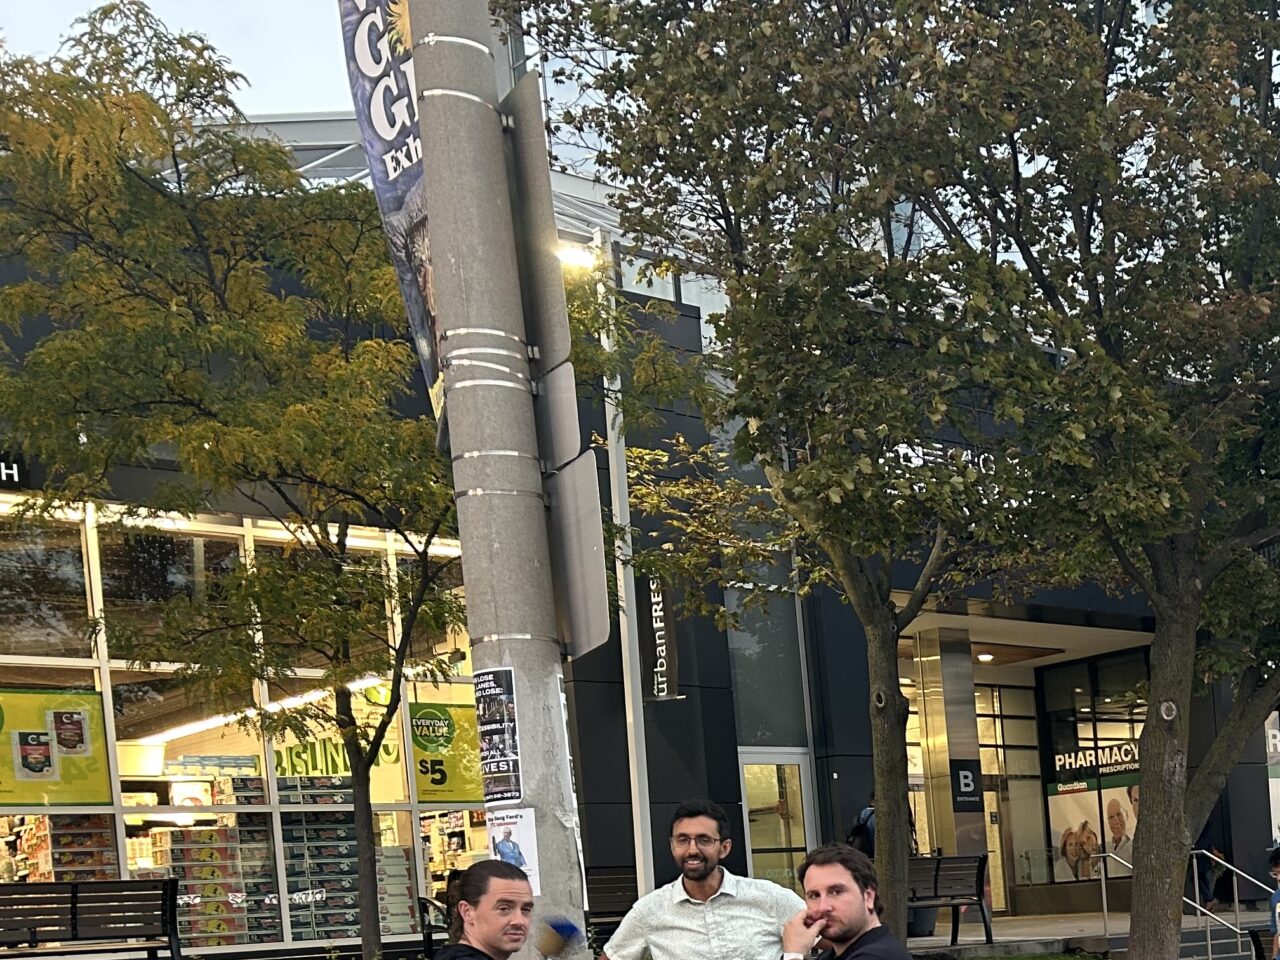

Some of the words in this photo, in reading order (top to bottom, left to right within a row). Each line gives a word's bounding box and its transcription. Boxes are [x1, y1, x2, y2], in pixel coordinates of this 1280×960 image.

[0, 462, 19, 482] H
[649, 567, 668, 696] urbanFRES
[412, 719, 449, 727] EVERYDAY
[413, 726, 450, 737] VALUE
[1055, 743, 1139, 771] PHARMACY
[418, 758, 448, 786] $5
[1099, 763, 1139, 774] PRESCRIPTION
[958, 770, 975, 792] B
